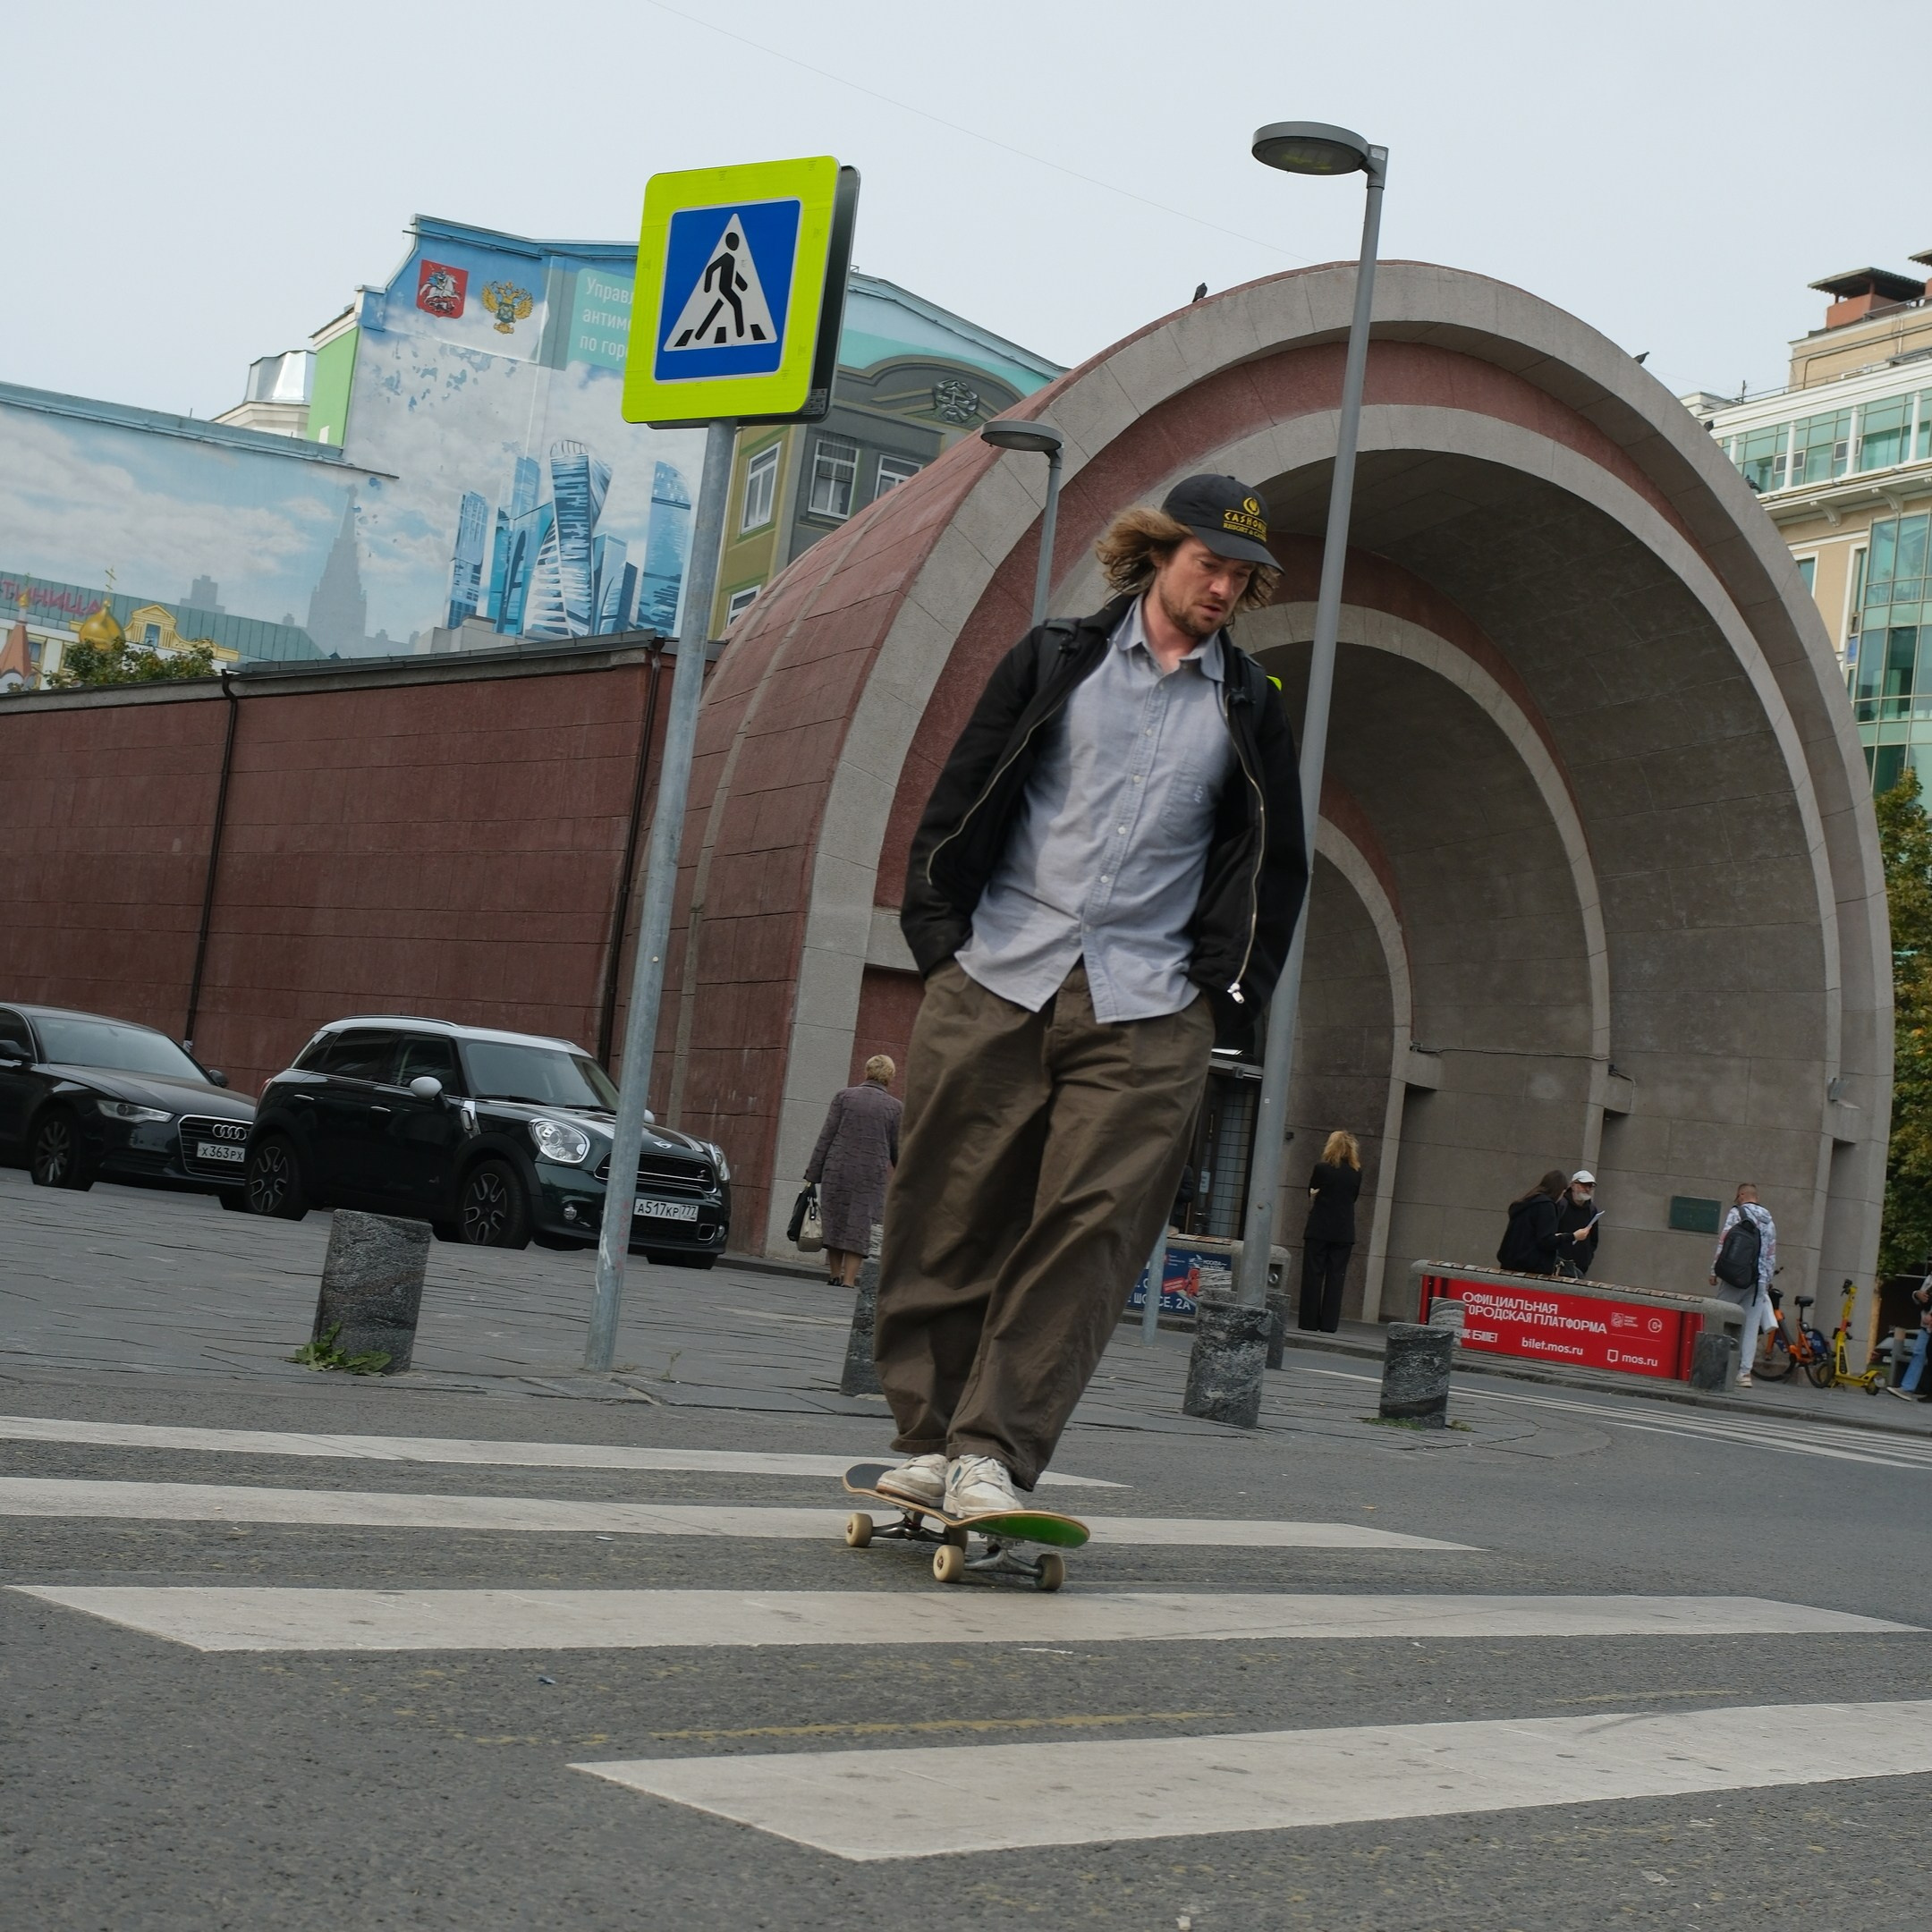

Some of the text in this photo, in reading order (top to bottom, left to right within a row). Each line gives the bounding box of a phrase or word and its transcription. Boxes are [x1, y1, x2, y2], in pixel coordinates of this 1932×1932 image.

[582, 309, 631, 332] антим
[580, 335, 628, 361] по гор
[1462, 1292, 1558, 1315] ОФИЦИАЛЬНАЯ
[1534, 1313, 1607, 1335] ПЛАТФОРМА
[1521, 1337, 1583, 1356] bilet.mos.ru
[1622, 1353, 1658, 1367] mos.ru
